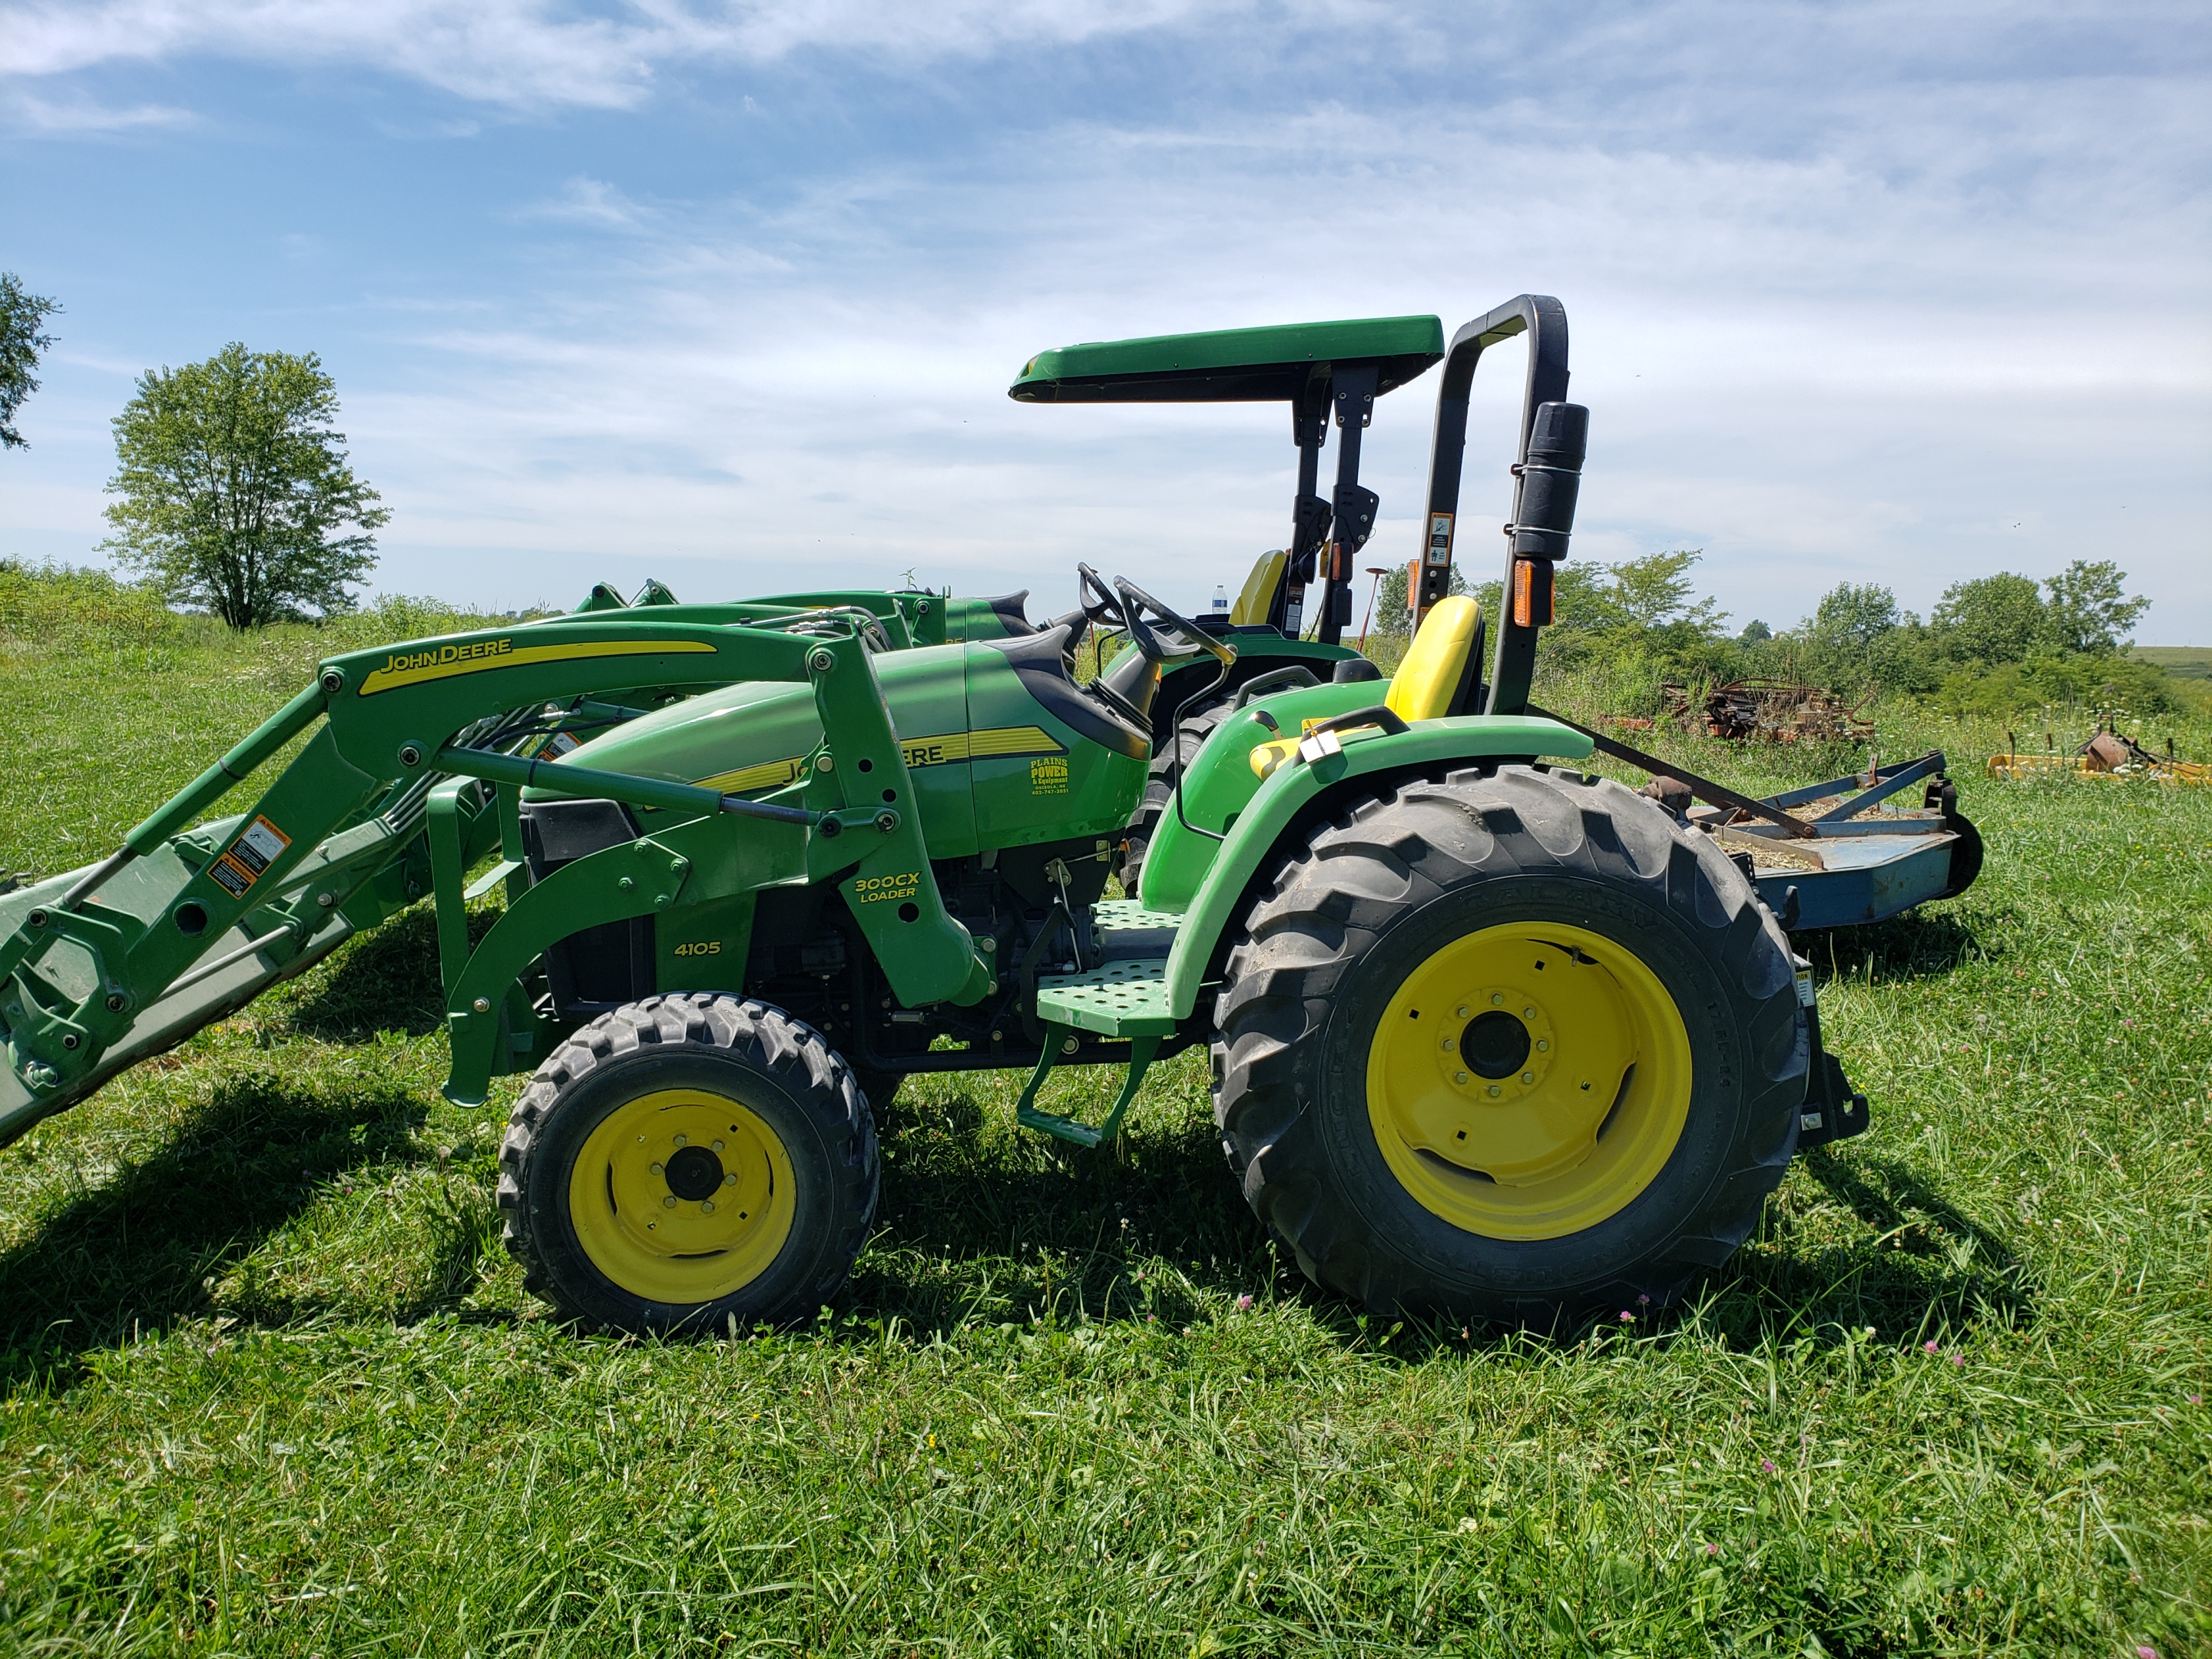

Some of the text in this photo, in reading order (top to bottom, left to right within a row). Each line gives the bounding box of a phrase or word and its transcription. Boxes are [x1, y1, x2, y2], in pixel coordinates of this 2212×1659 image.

[380, 638, 512, 673] JOHN DEERE
[902, 745, 944, 765] ERE
[1031, 757, 1068, 769] PLAINS
[1031, 766, 1068, 778] POWER
[265, 822, 287, 843] WARNING
[230, 861, 253, 881] WARNING
[855, 871, 921, 892] 300CX
[860, 887, 916, 903] LOADER
[674, 941, 721, 956] 4105
